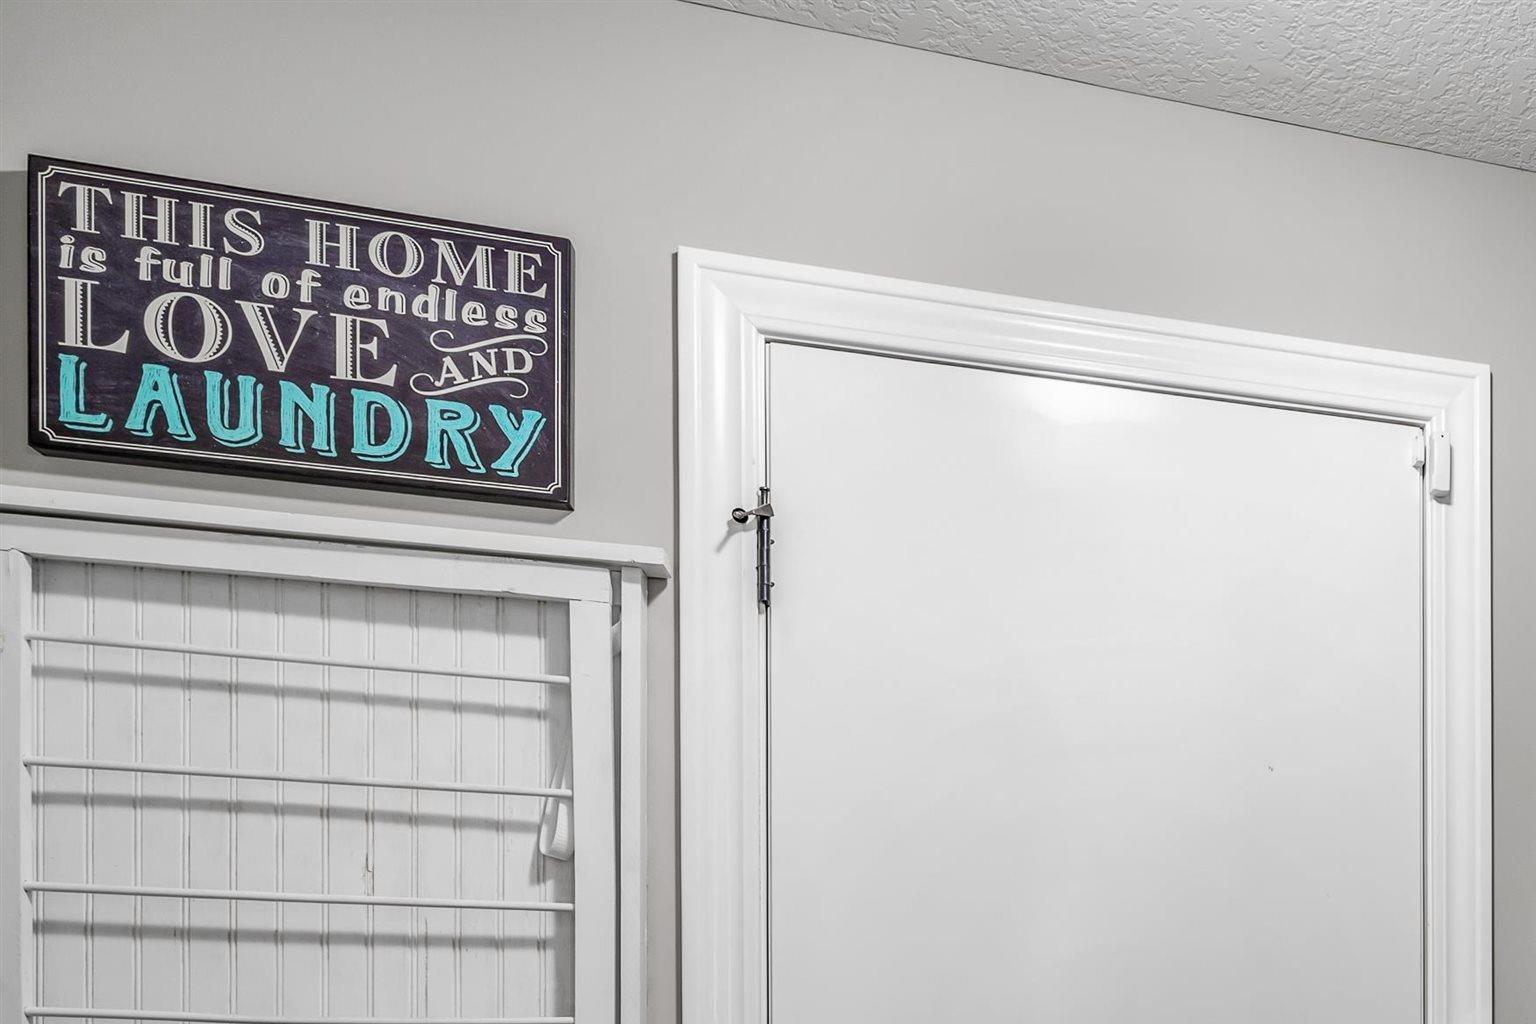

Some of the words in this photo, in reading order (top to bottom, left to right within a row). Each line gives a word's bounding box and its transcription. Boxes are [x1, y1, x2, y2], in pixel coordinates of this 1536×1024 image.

[58, 182, 265, 256] THIS
[305, 218, 547, 298] HOME
[59, 235, 107, 272] is
[134, 246, 232, 290] full
[261, 269, 321, 303] of
[344, 284, 547, 333] endless
[58, 276, 398, 386] LOVE
[435, 346, 533, 388] AND
[57, 353, 546, 477] LAUNDRY
